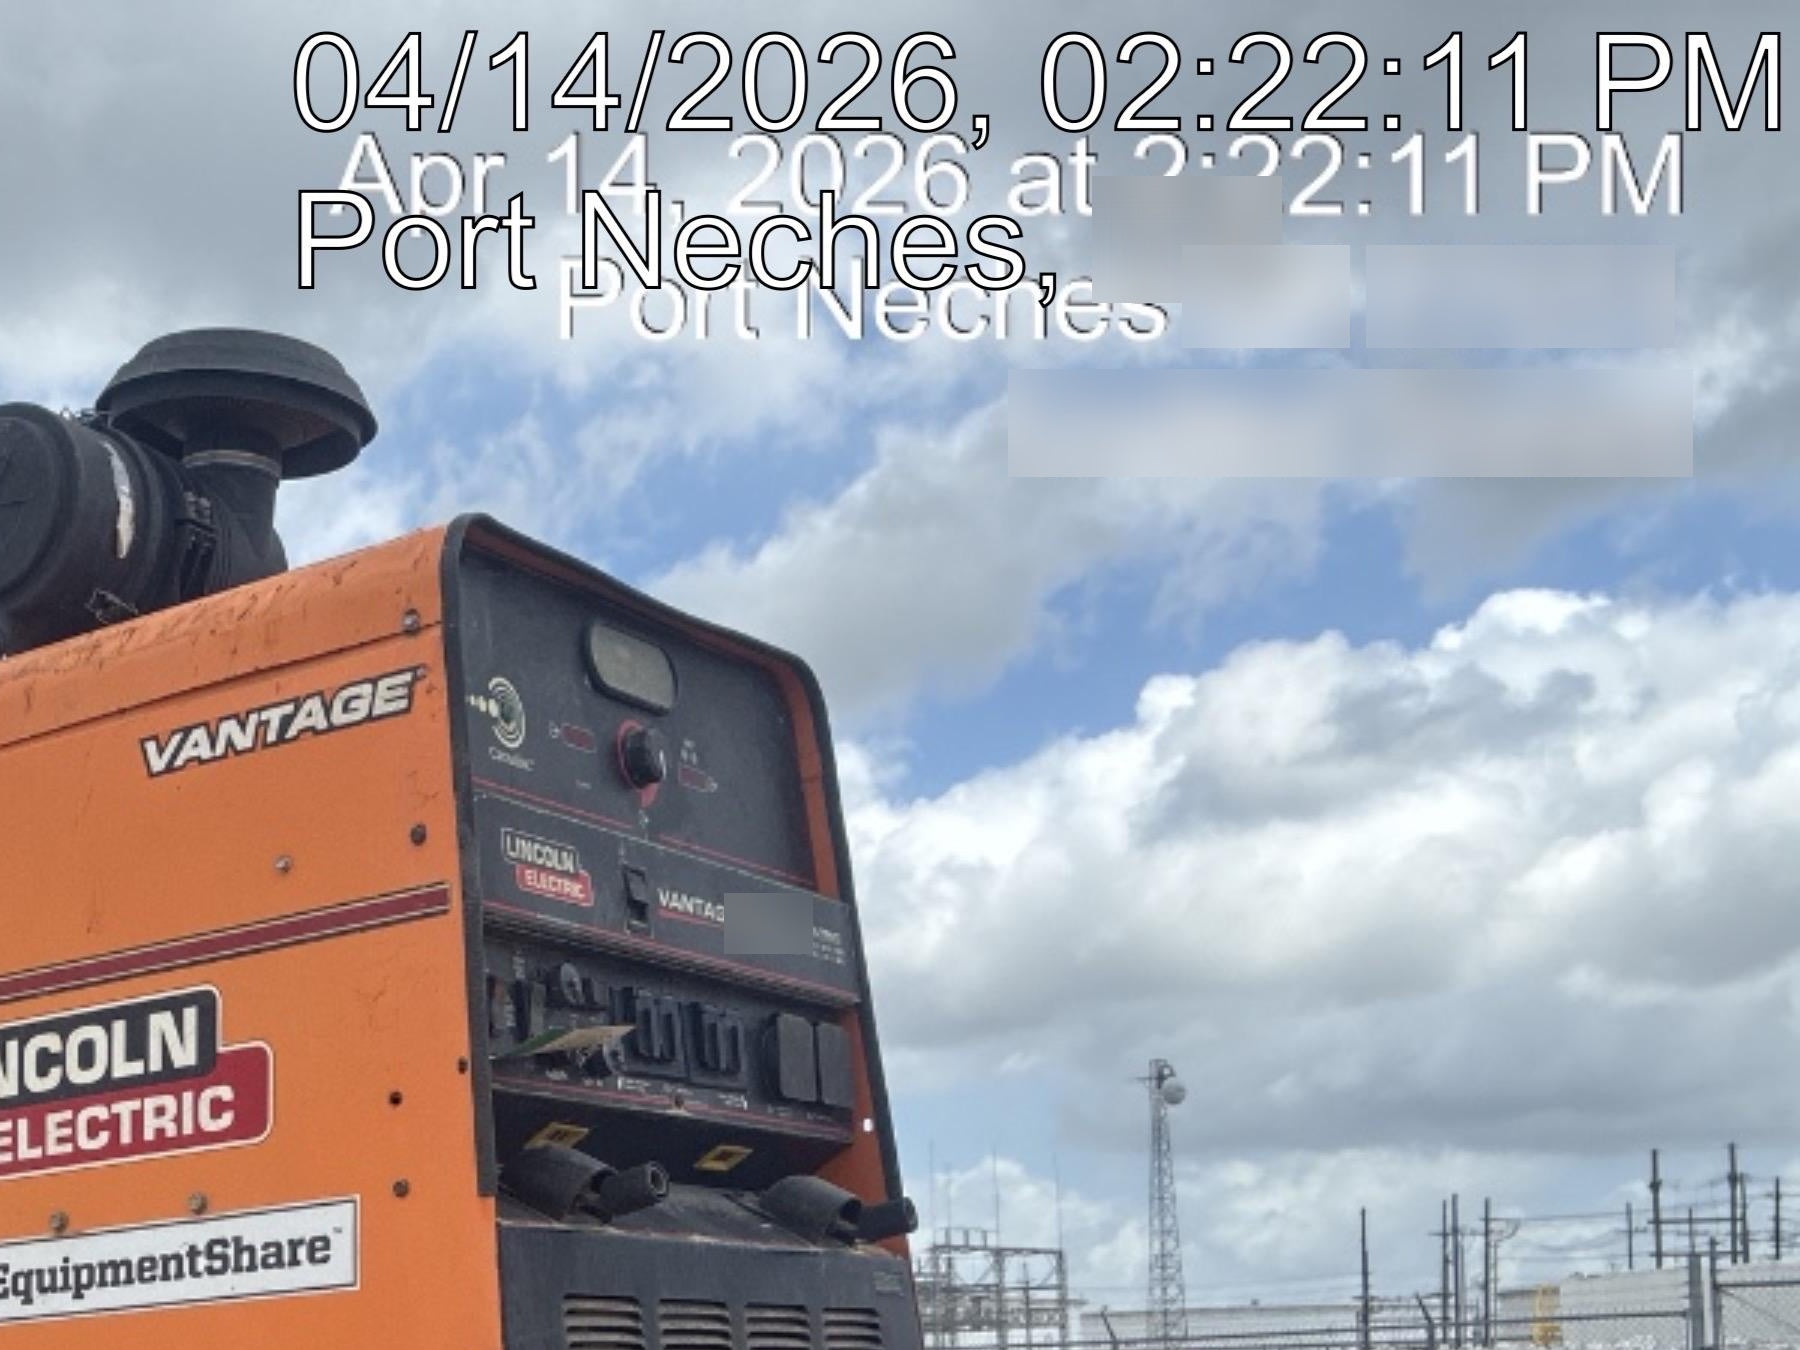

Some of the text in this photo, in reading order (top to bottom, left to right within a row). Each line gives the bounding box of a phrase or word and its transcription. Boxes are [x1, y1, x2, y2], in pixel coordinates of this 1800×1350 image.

[141, 666, 416, 777] VANTAGE
[505, 832, 576, 875] LINCOLN
[656, 886, 725, 923] VANTAG
